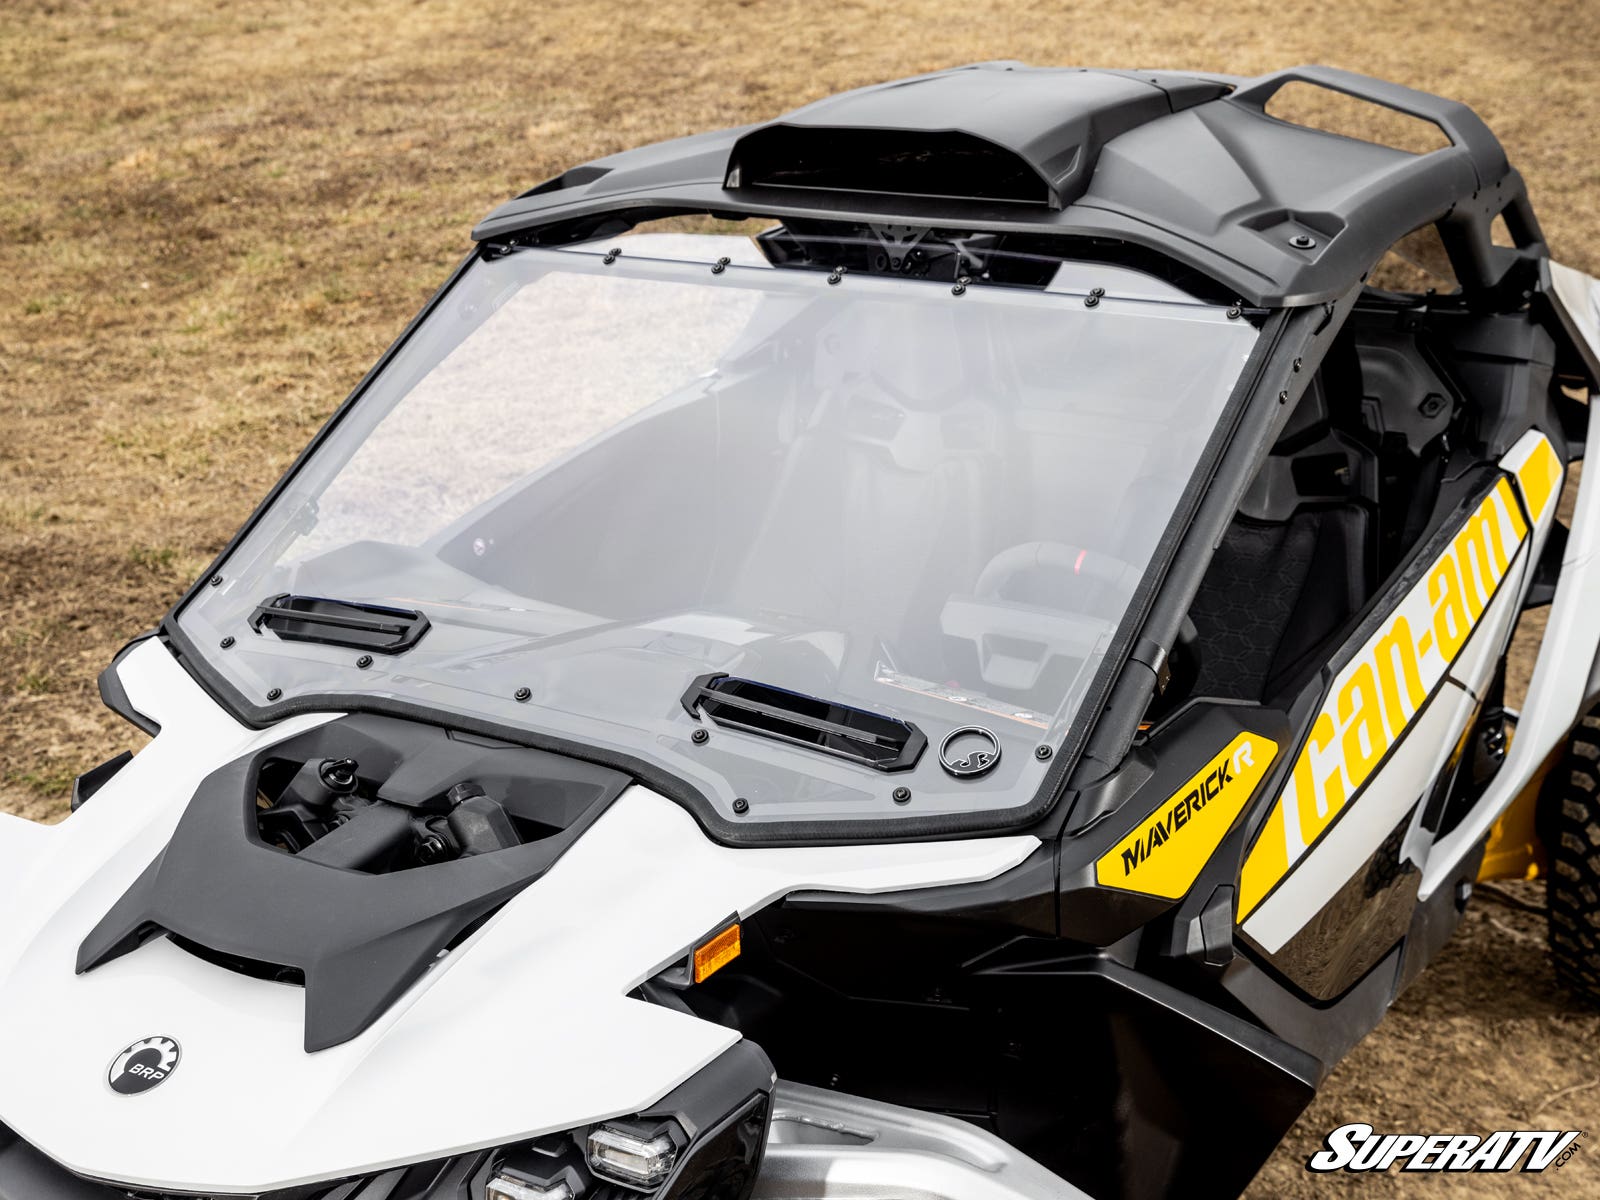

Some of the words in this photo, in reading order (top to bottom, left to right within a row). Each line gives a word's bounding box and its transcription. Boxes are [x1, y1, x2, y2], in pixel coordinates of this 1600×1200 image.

[1292, 495, 1510, 847] can-am
[1121, 758, 1233, 877] MAVERICK
[1232, 740, 1255, 775] R
[128, 1063, 165, 1080] BRP
